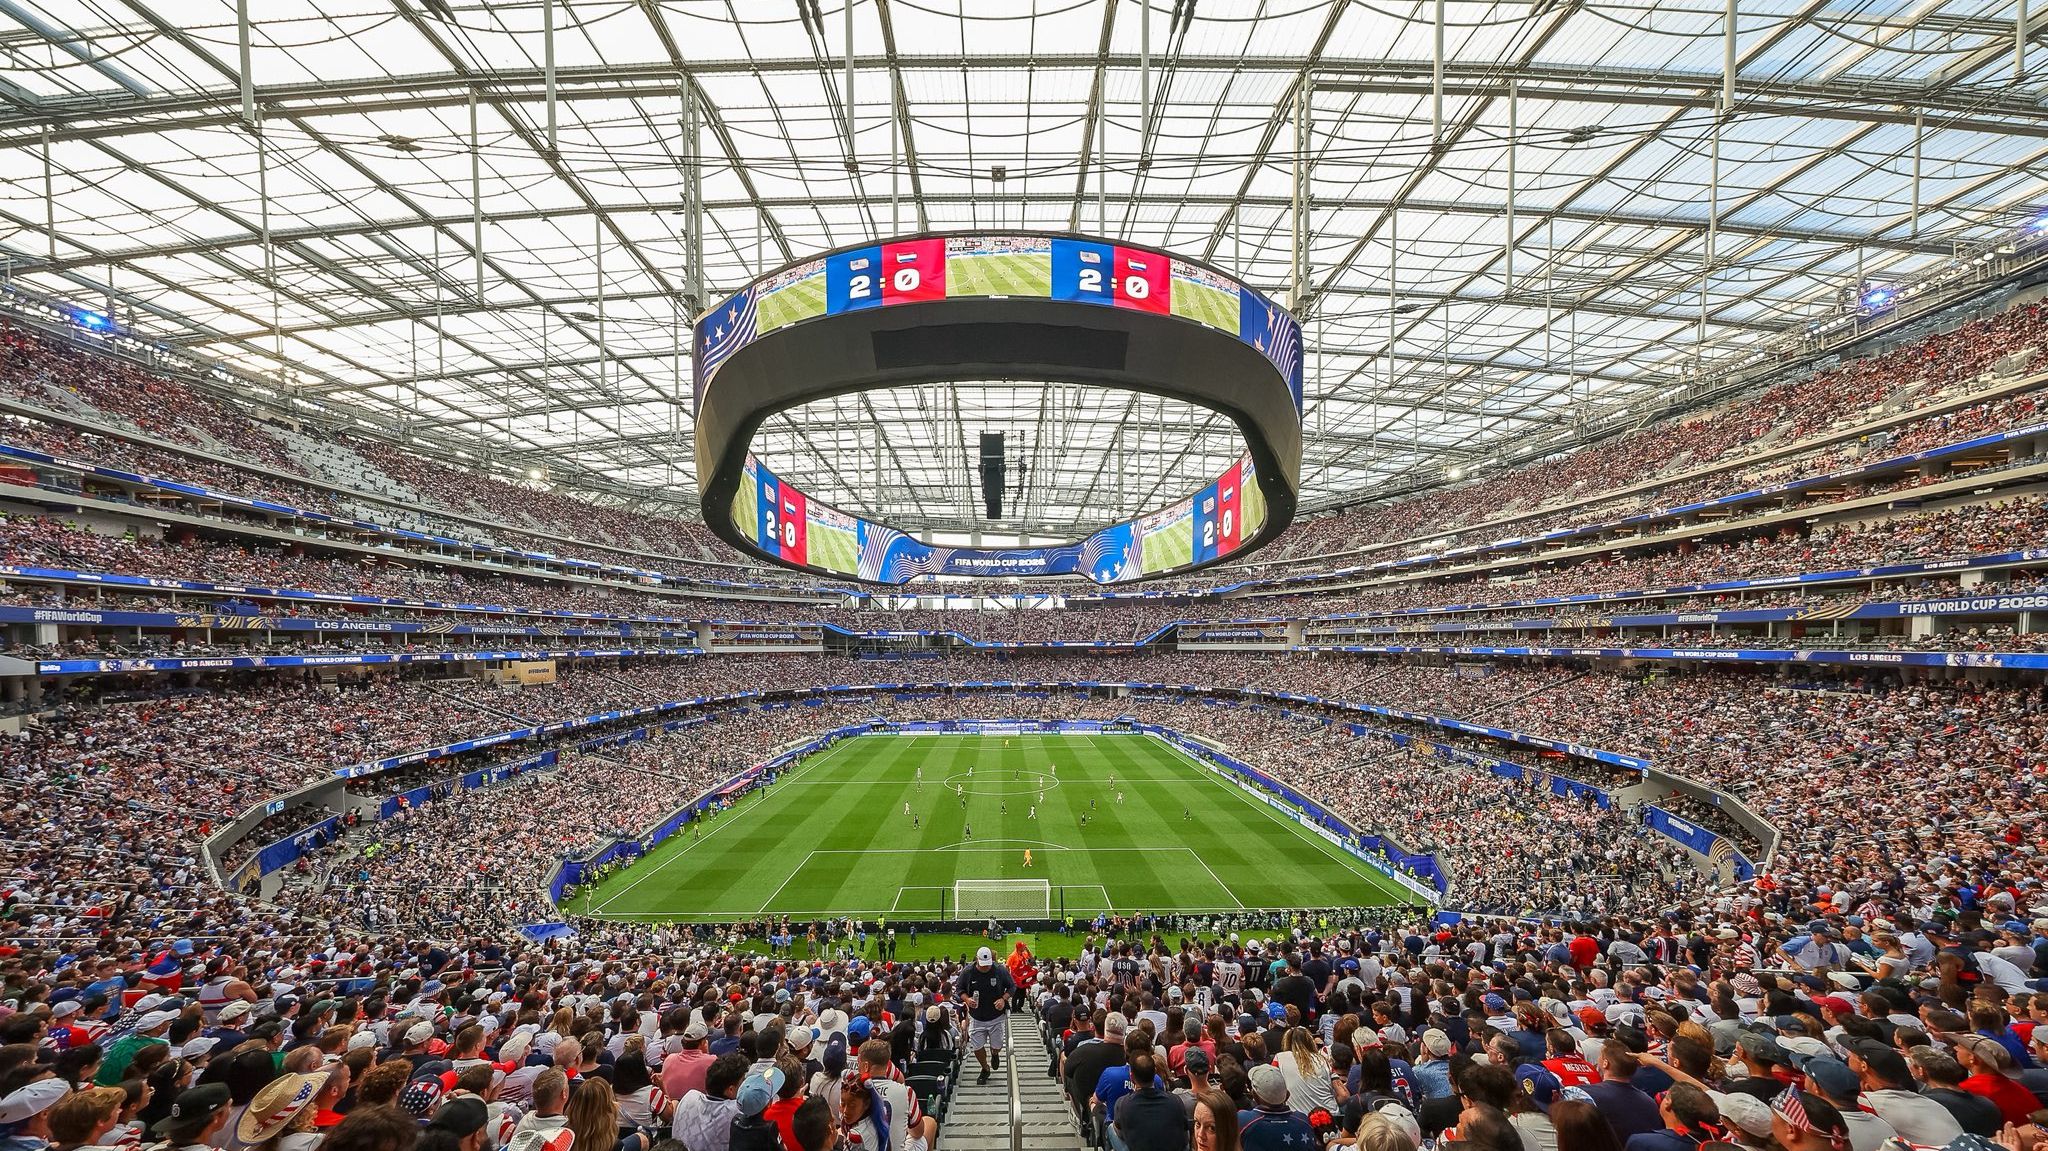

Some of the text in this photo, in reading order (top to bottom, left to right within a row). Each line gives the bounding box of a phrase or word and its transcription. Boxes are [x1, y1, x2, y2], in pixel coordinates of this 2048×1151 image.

[850, 276, 870, 298] 2
[894, 268, 920, 292] 0
[1079, 268, 1102, 292] 2
[1126, 276, 1149, 299] 0
[766, 510, 776, 540] 2
[785, 522, 796, 548] 0
[1204, 520, 1214, 547] 2
[1222, 510, 1232, 538] 0
[34, 610, 102, 623] #FIFAWorldCup
[1900, 596, 2048, 614] FIFA WORLD CUP 2026
[1223, 973, 1237, 987] 10
